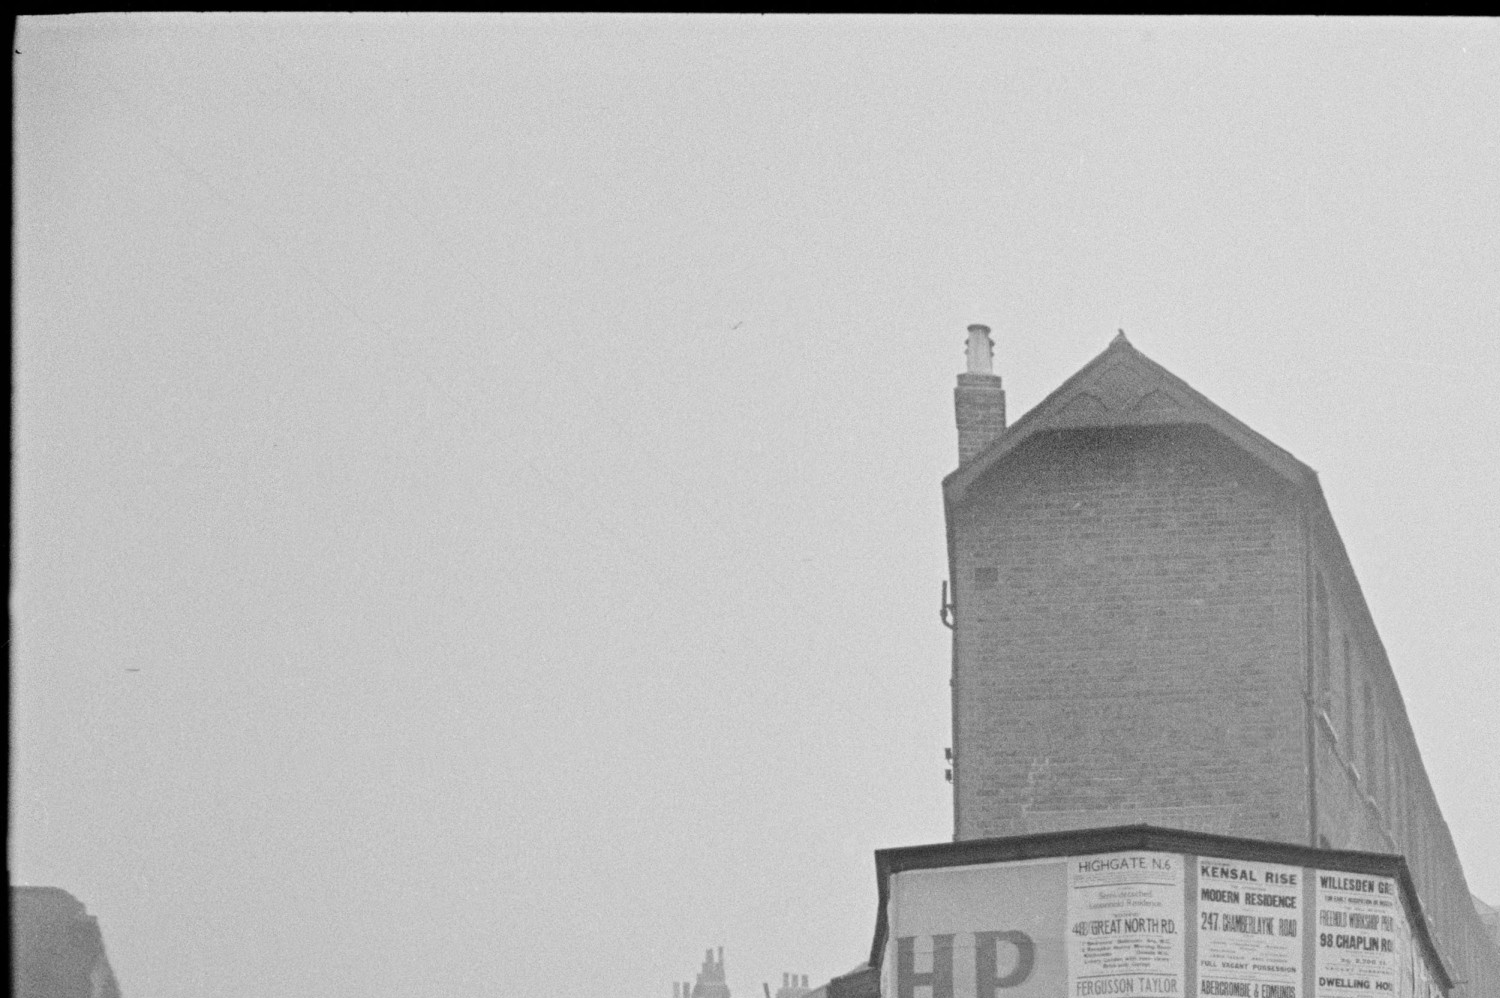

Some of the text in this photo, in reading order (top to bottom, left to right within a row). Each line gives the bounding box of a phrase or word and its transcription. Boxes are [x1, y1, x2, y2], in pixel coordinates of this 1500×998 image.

[1078, 857, 1146, 873] HIGHGATE
[1200, 865, 1298, 886] KENSAL RISE
[1320, 875, 1375, 893] WILLESDEN
[1201, 887, 1298, 910] MODERN RESIDENCE
[1090, 918, 1122, 936] GREAT
[1124, 917, 1159, 934] NORTH
[1278, 917, 1298, 938] ROAD
[1320, 932, 1334, 948] 98
[1335, 933, 1379, 952] CHAPLIN
[1076, 977, 1178, 996] FERGUSSON TAYLOR
[1201, 979, 1251, 998] ABERCROMBIE
[1318, 976, 1371, 990] DWELLING
